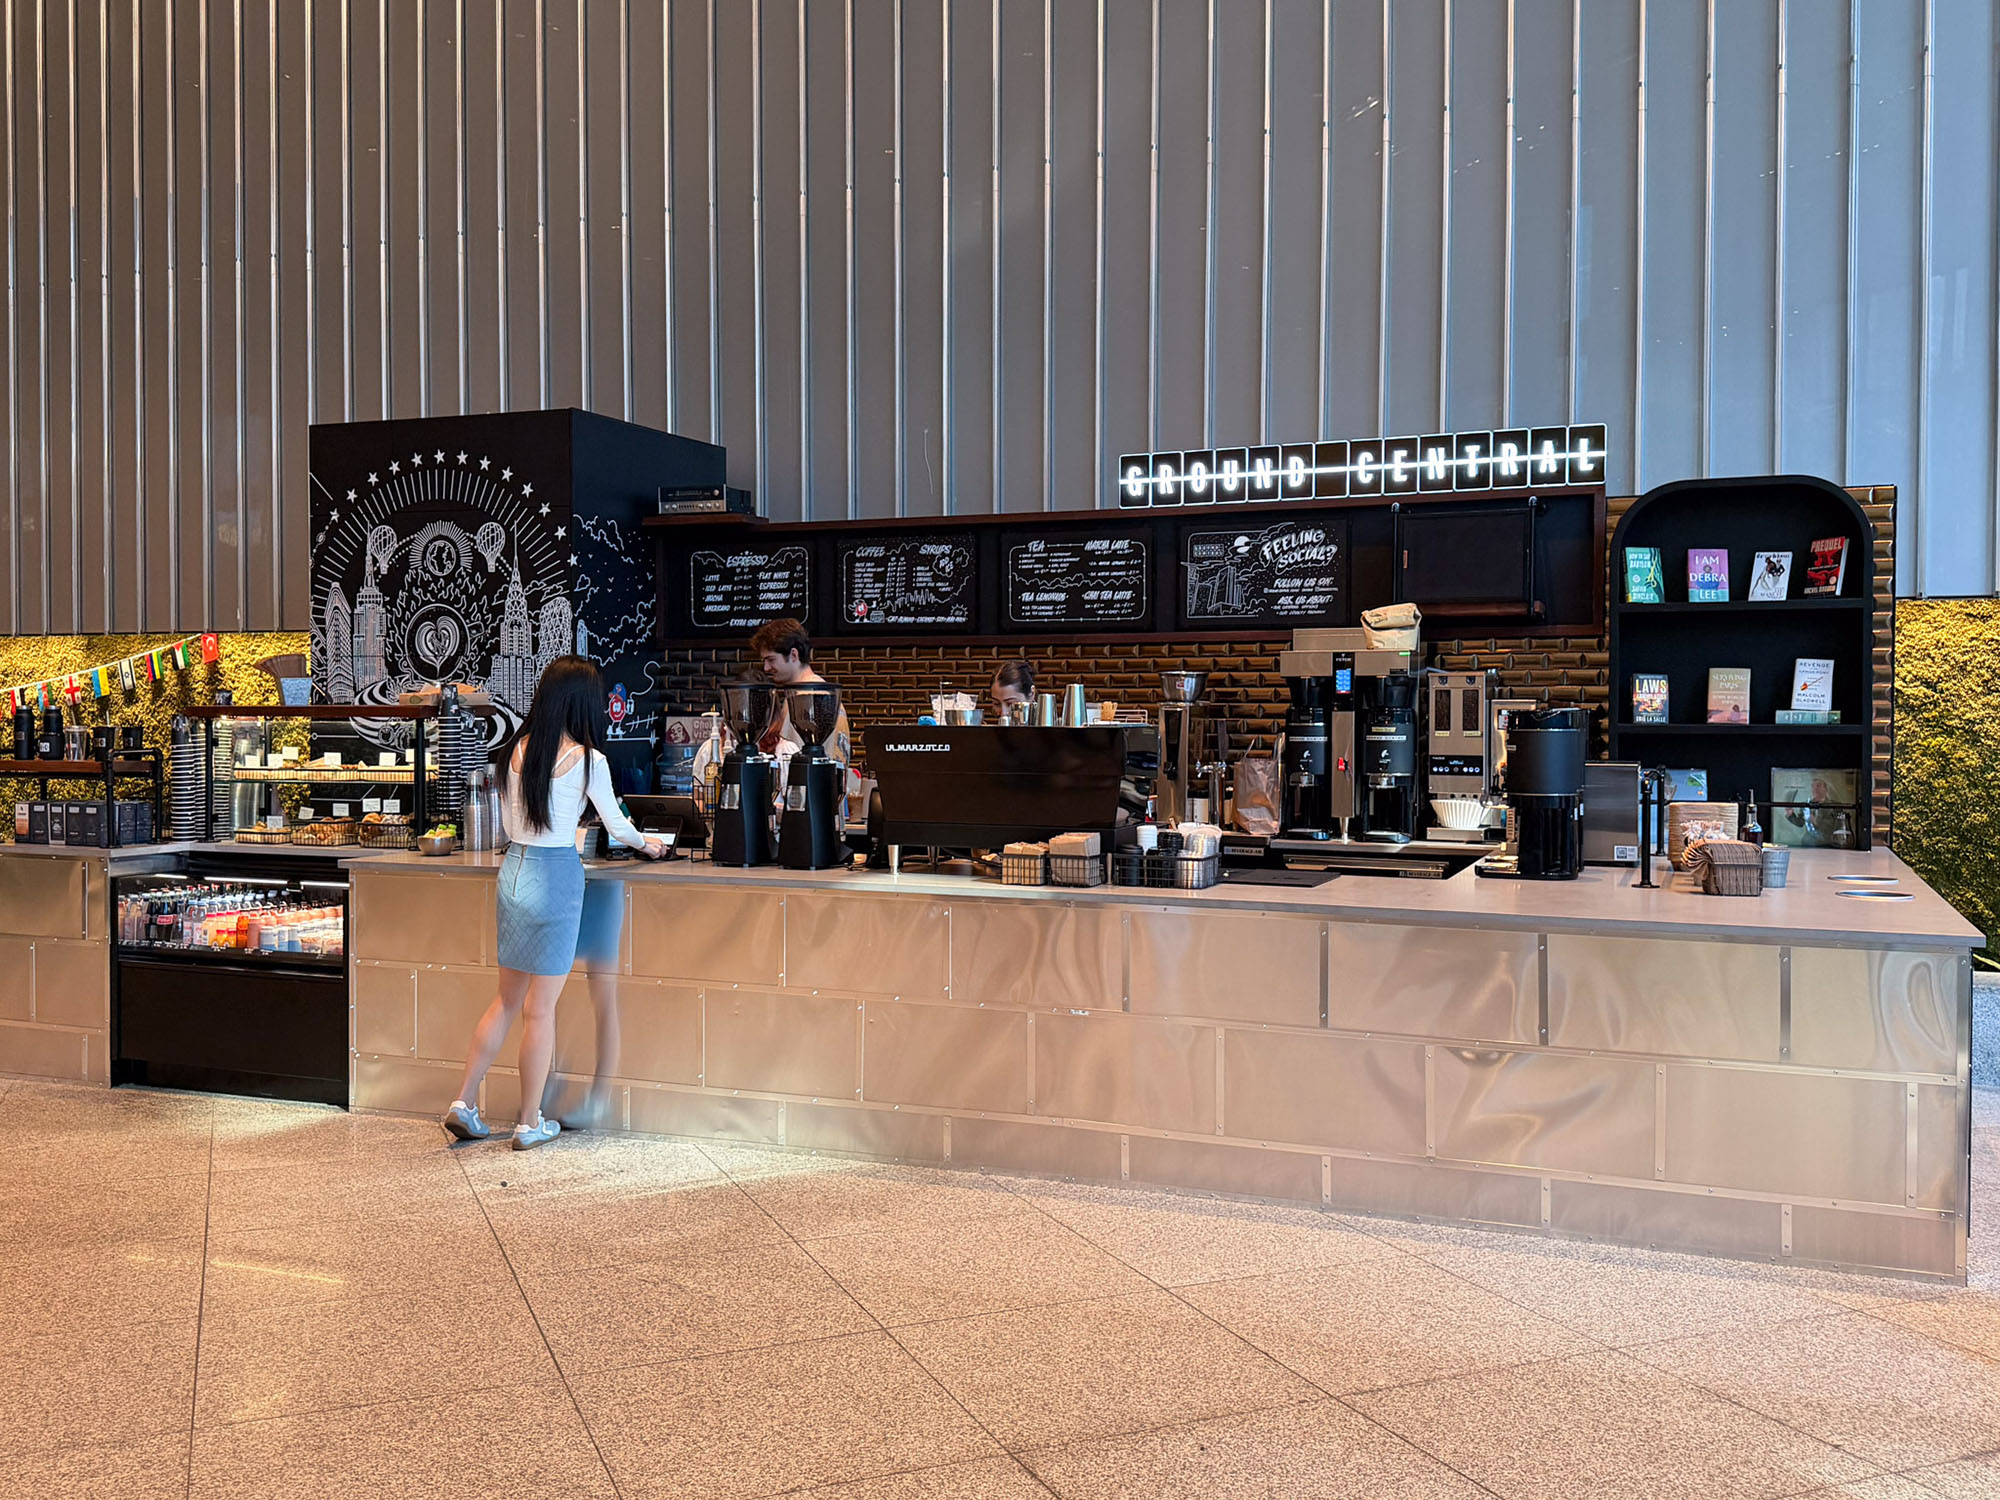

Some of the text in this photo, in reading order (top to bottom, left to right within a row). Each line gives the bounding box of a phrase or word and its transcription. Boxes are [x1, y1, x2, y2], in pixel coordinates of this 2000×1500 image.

[1126, 438, 1595, 496] GROUND CENTRAL
[919, 544, 952, 555] SYRUPS
[1028, 540, 1045, 552] TEA
[1111, 539, 1130, 550] LATTE
[1263, 529, 1324, 560] FEELING
[1810, 538, 1842, 552] PREQUEL
[856, 546, 885, 557] COFFEE
[1278, 544, 1337, 568] SOCIAL?
[726, 555, 768, 568] ESPRESSO
[1701, 555, 1720, 565] AM
[705, 574, 720, 582] LATTE
[759, 571, 772, 580] FLAT
[1689, 572, 1727, 582] DEBRA
[718, 584, 732, 592] LATTE
[759, 581, 789, 590] ESPRESSO
[1273, 578, 1303, 588] FOLLOW
[1303, 577, 1317, 587] US
[1021, 592, 1034, 602] TEA
[1100, 590, 1112, 600] TEA
[1113, 590, 1133, 600] LATTE
[1277, 595, 1294, 605] ASK
[1295, 595, 1307, 604] US
[1700, 589, 1717, 600] LEE
[730, 619, 747, 627] EXTRA
[1636, 679, 1667, 694] LAWS
